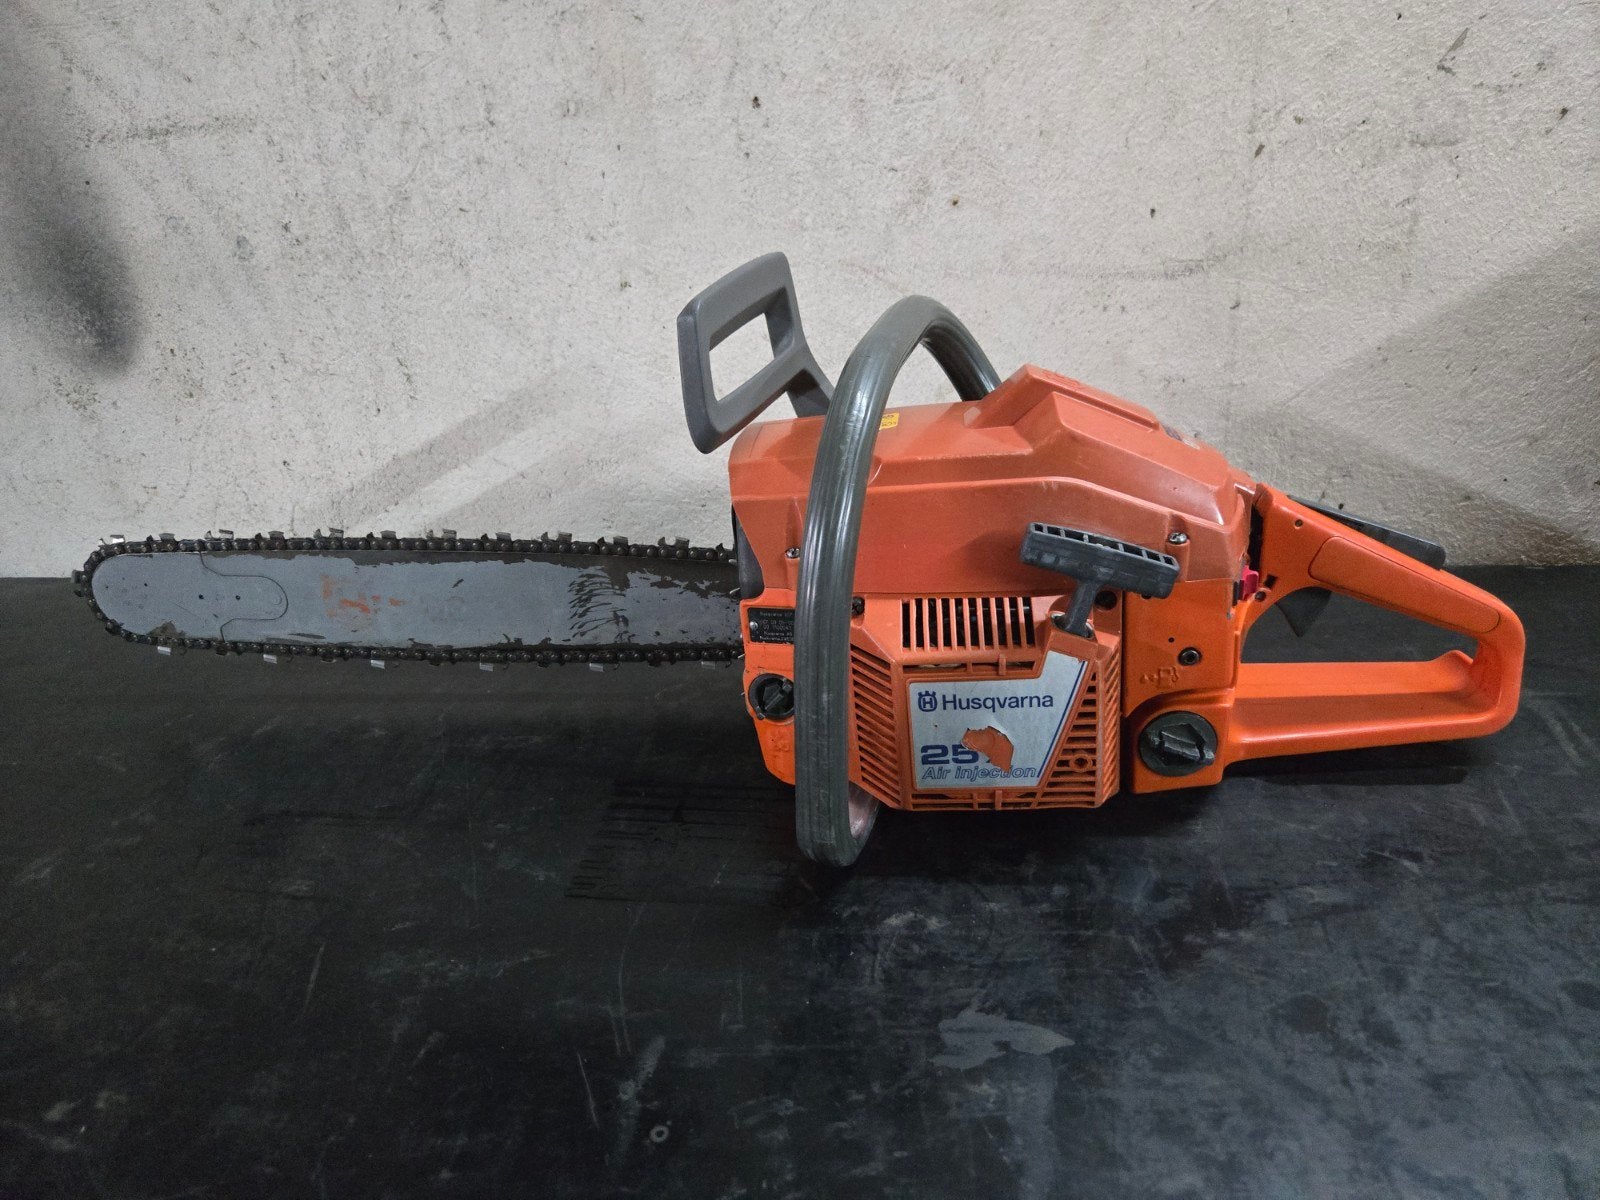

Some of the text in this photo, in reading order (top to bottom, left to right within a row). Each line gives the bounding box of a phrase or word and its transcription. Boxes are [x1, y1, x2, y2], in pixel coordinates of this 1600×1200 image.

[942, 694, 1054, 713] Husqvarna
[920, 744, 990, 765] 25
[921, 766, 952, 780] Air
